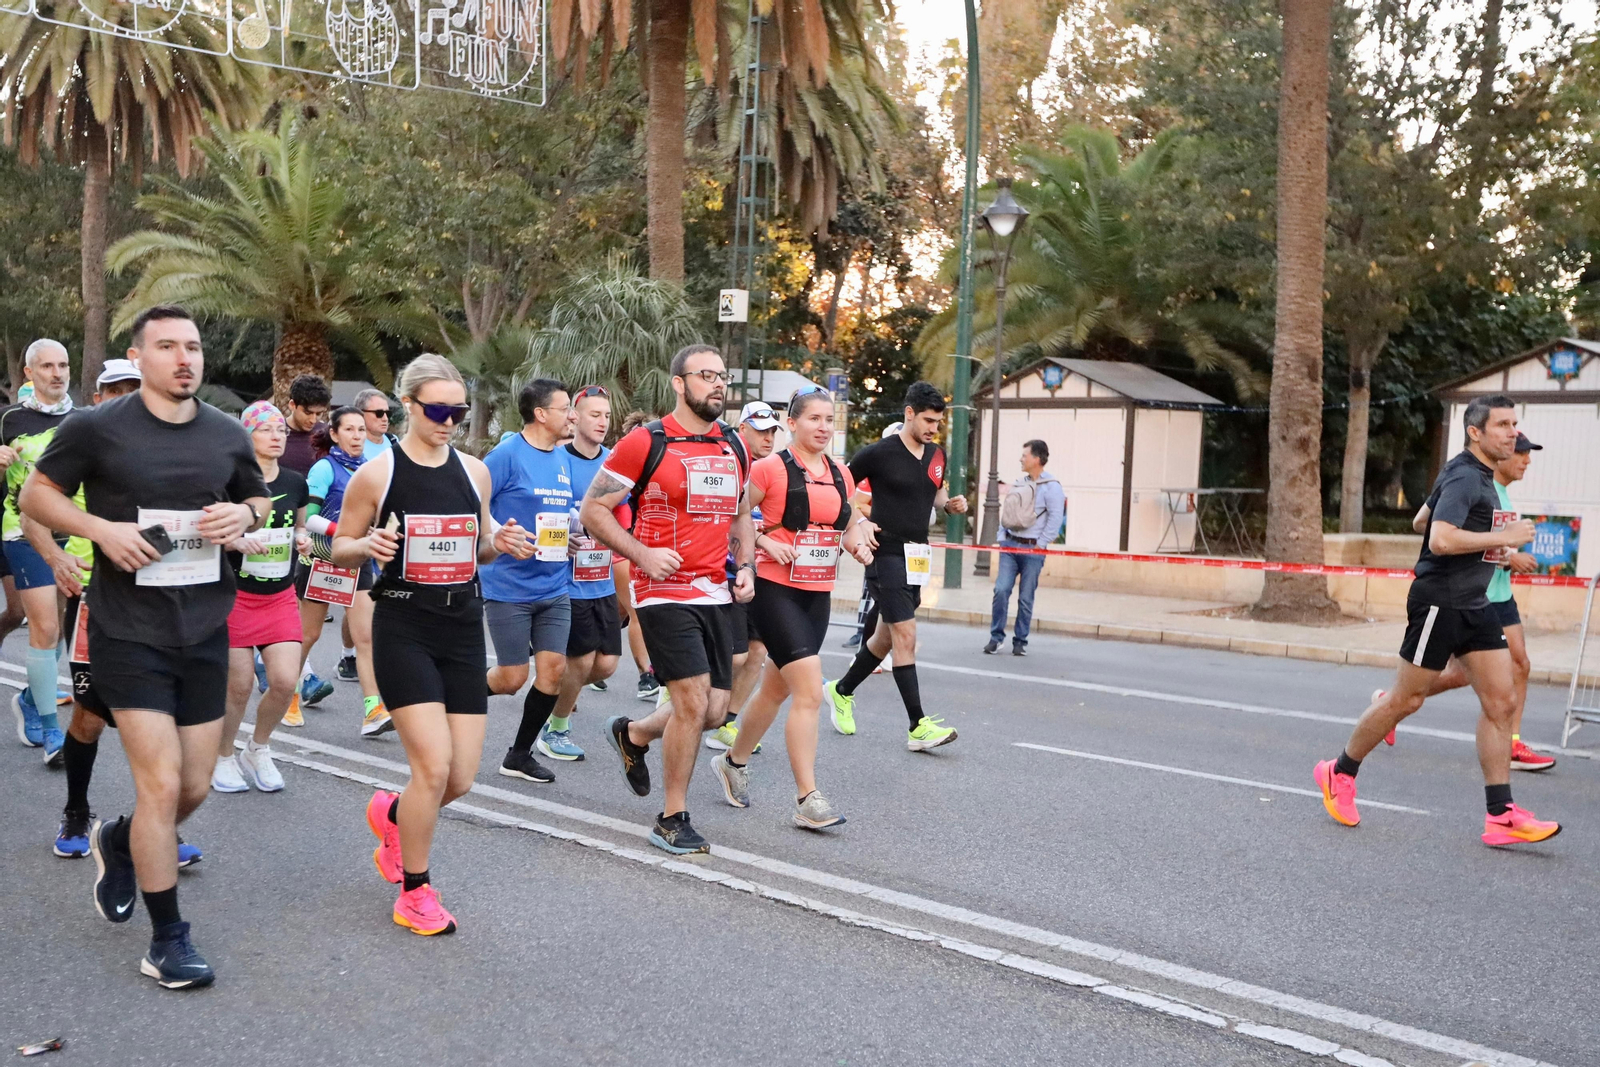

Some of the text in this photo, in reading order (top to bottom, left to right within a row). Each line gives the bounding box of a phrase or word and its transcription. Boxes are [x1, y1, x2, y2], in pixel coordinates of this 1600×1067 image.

[475, 0, 535, 44] FUN
[448, 30, 509, 86] FUN
[703, 477, 724, 486] 4367
[429, 541, 457, 551] 4401
[1531, 541, 1565, 558] laga
[588, 552, 604, 561] 4502
[809, 549, 830, 558] 4305
[323, 575, 343, 586] 4503
